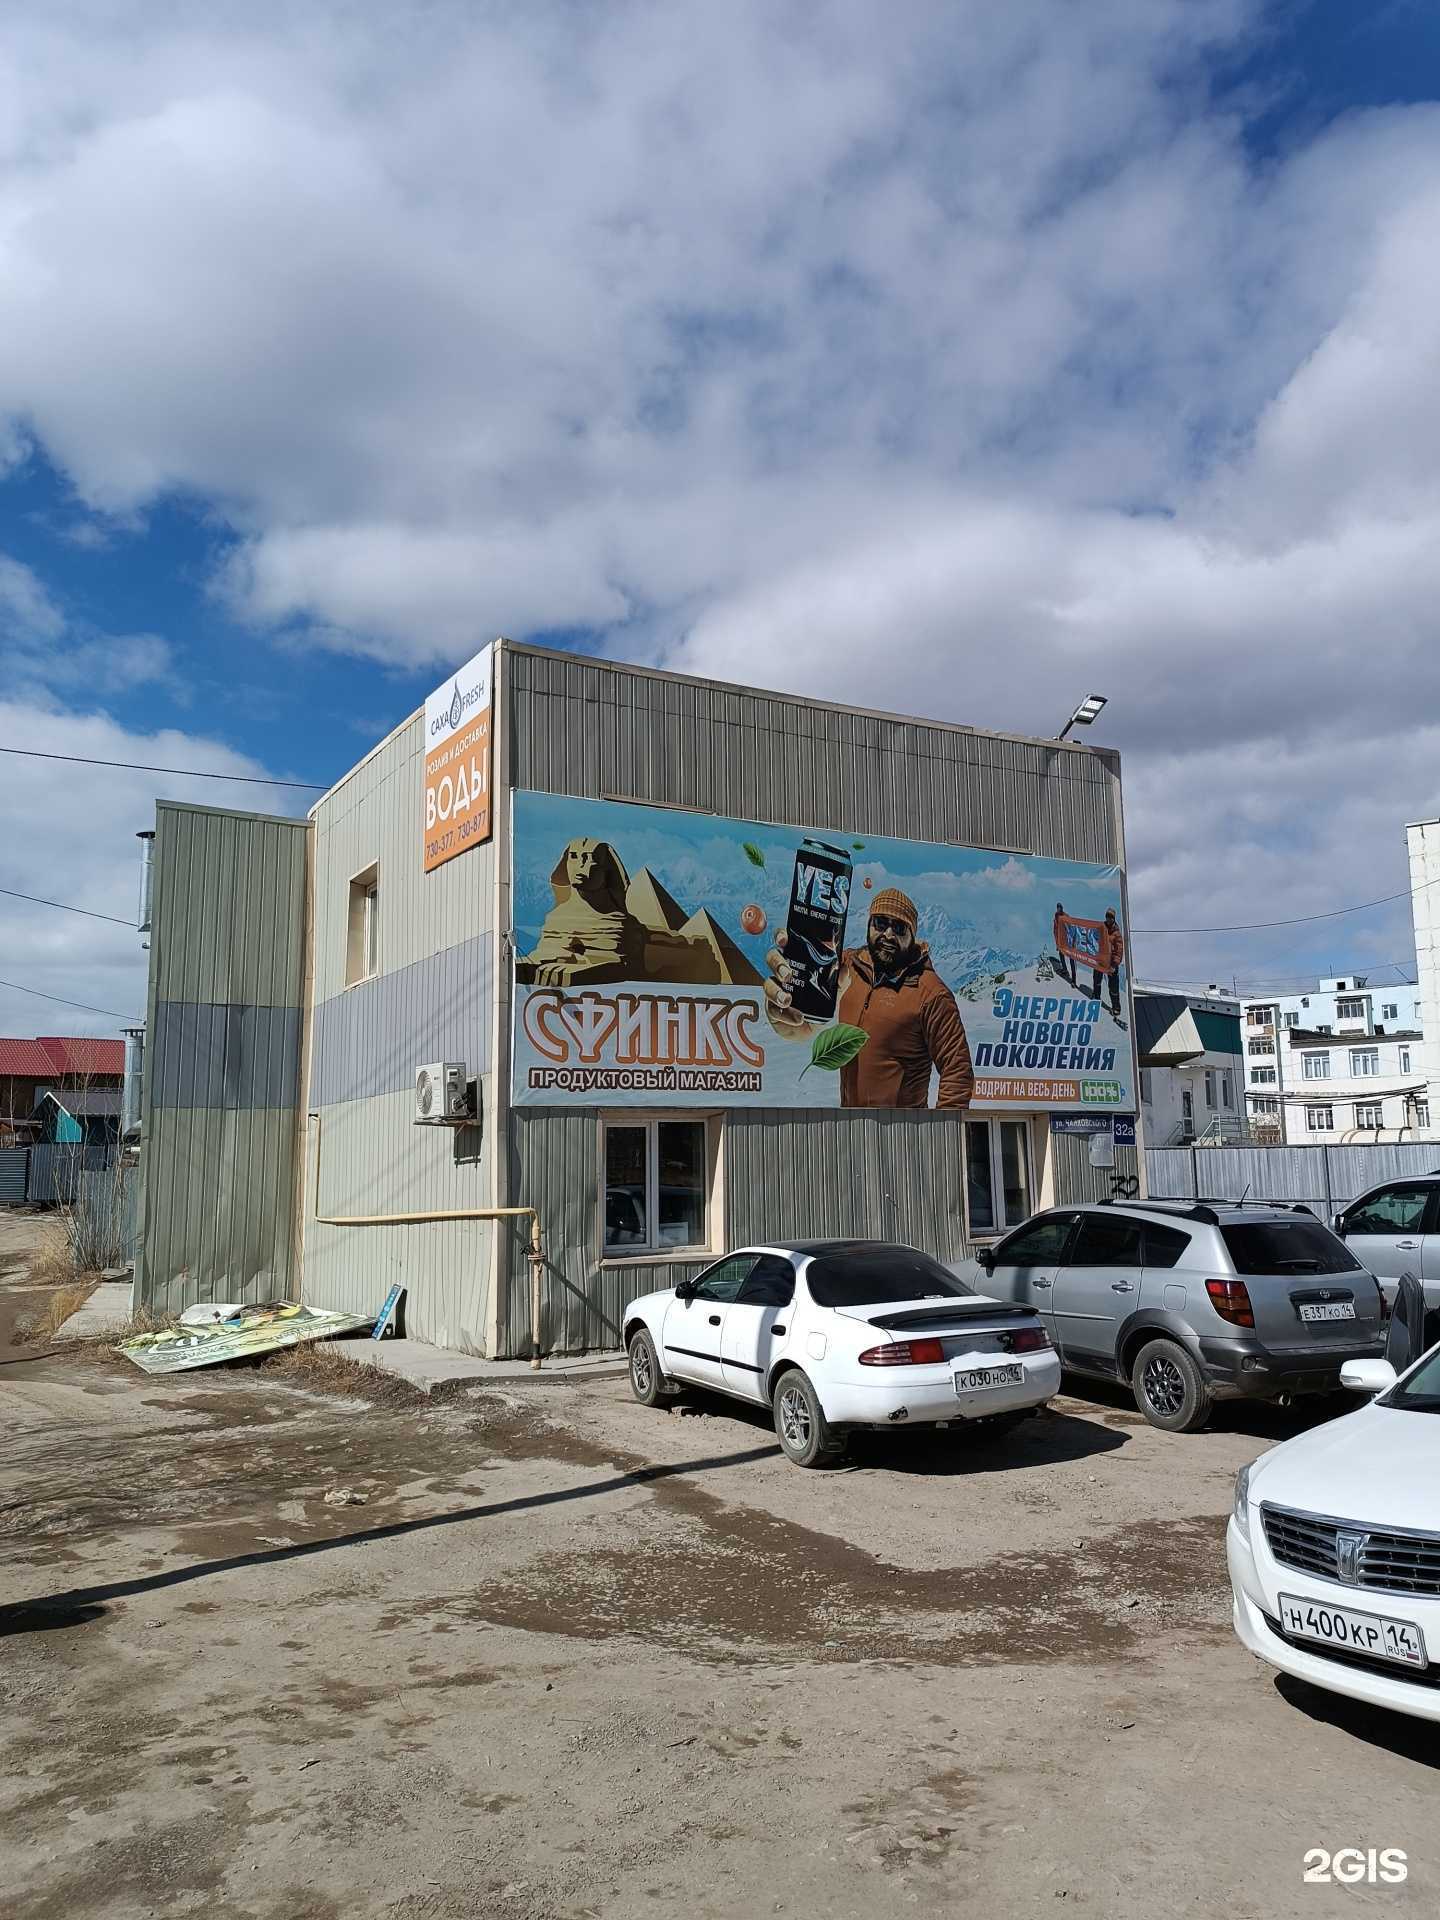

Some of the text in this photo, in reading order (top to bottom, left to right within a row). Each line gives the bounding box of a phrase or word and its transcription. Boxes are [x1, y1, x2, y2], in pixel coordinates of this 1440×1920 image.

[461, 680, 485, 710] FRESH
[431, 711, 449, 736] САХА
[427, 721, 488, 777] РОЗЛИВ И ДОСТАВКА
[426, 747, 487, 831] ВОДЫ
[458, 810, 486, 840] 730-877
[796, 862, 850, 914] YES
[1065, 922, 1100, 956] YES
[524, 990, 764, 1067] СФИНКС
[1002, 1020, 1092, 1047] НОВОГО
[975, 1043, 1116, 1071] ПОКОЛЕНИЯ
[530, 1067, 761, 1090] ПРОДУКТОВЫЙ МАГАЗИН
[975, 1080, 1075, 1099] БОДРИТ НА ВЕСЬ ДЕНЬ
[1290, 1607, 1412, 1650] Н400КР 14
[1387, 1645, 1407, 1657] RUS
